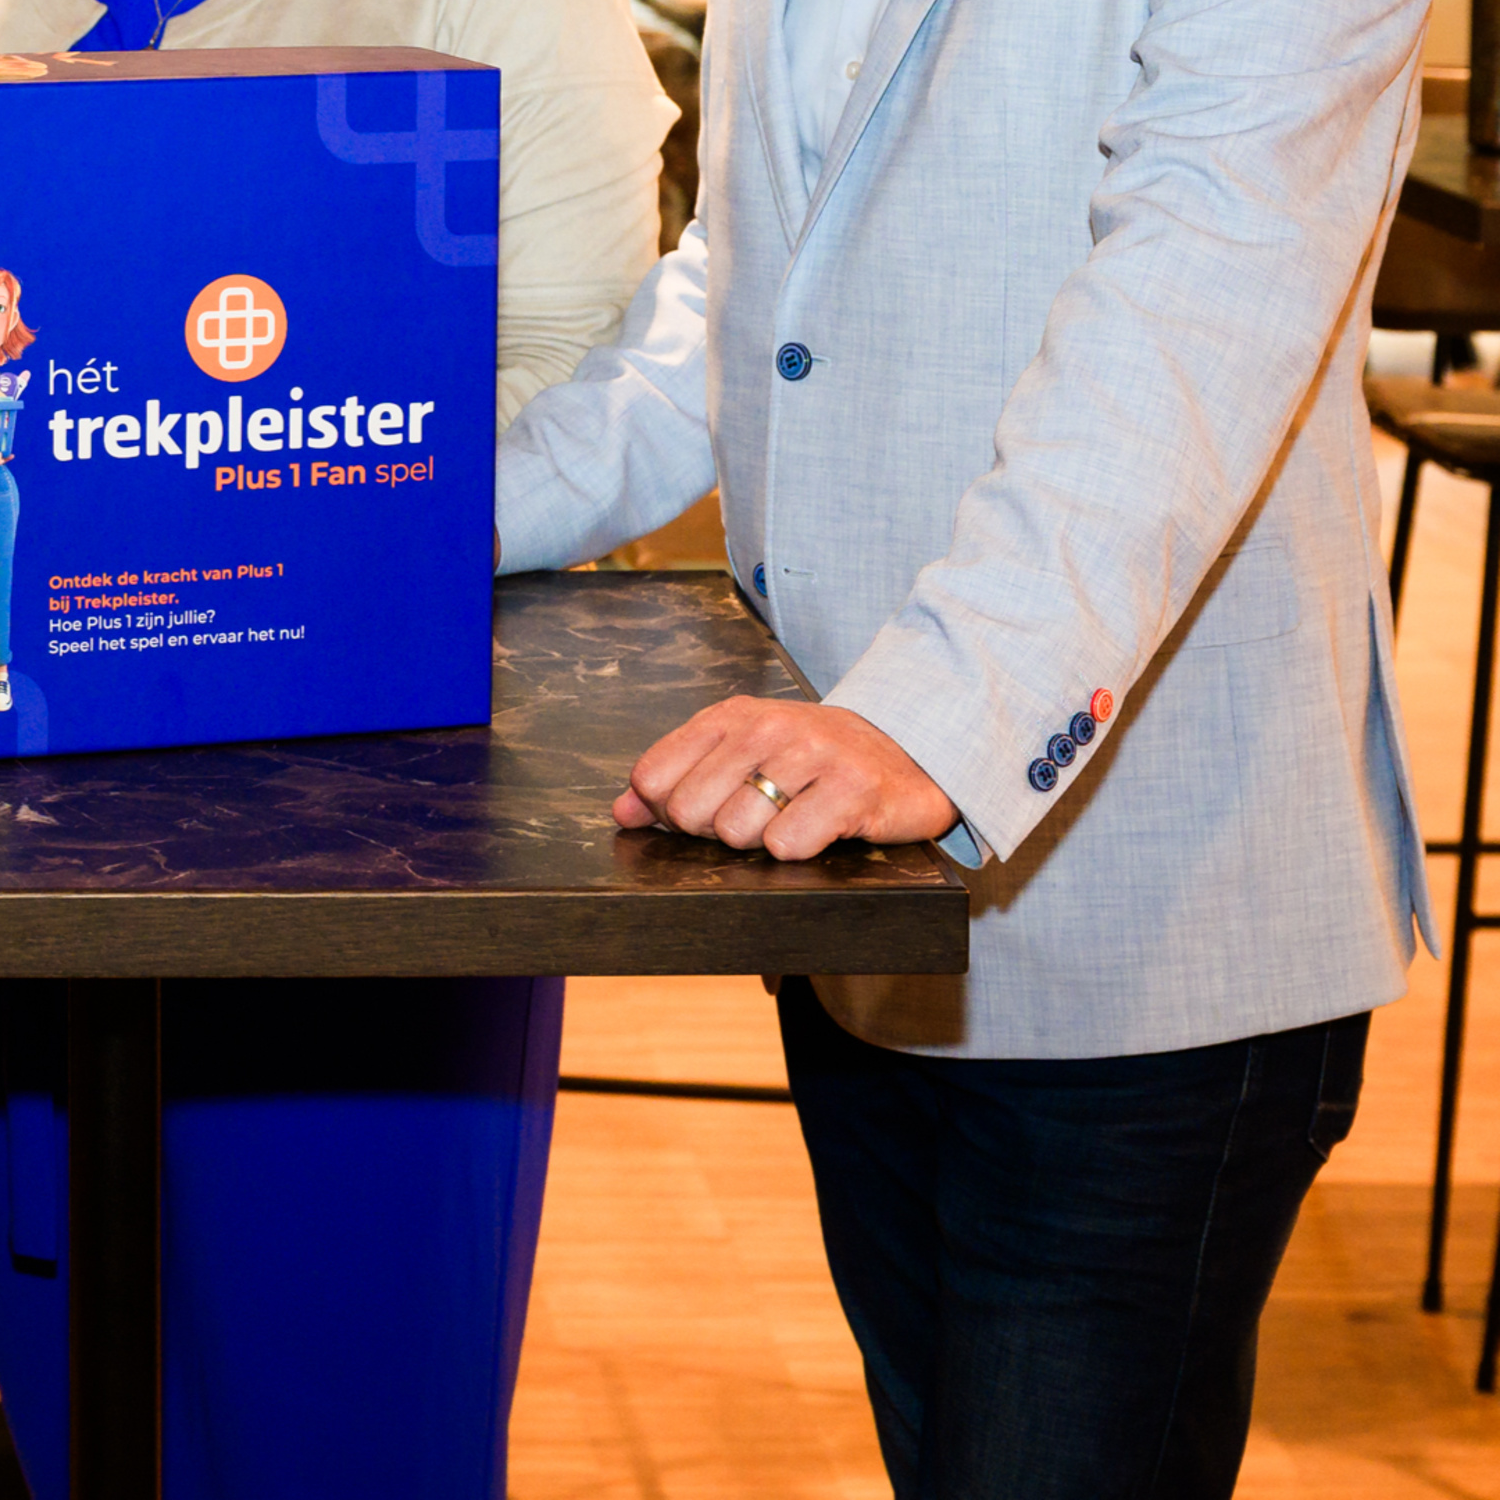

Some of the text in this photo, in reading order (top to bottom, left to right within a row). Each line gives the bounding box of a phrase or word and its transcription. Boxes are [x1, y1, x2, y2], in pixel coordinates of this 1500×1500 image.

[49, 357, 120, 396] hét
[49, 386, 435, 470] trekpleister
[215, 455, 434, 492] Plus 1 Fan spel
[48, 562, 284, 590] Ontdek de kracht van Plus 1
[48, 590, 180, 614] bij Trekpleister.
[49, 609, 216, 633] Hoe Plus 1 zijn jullie?
[48, 625, 306, 657] Speel het spel en ervaar het nu!
